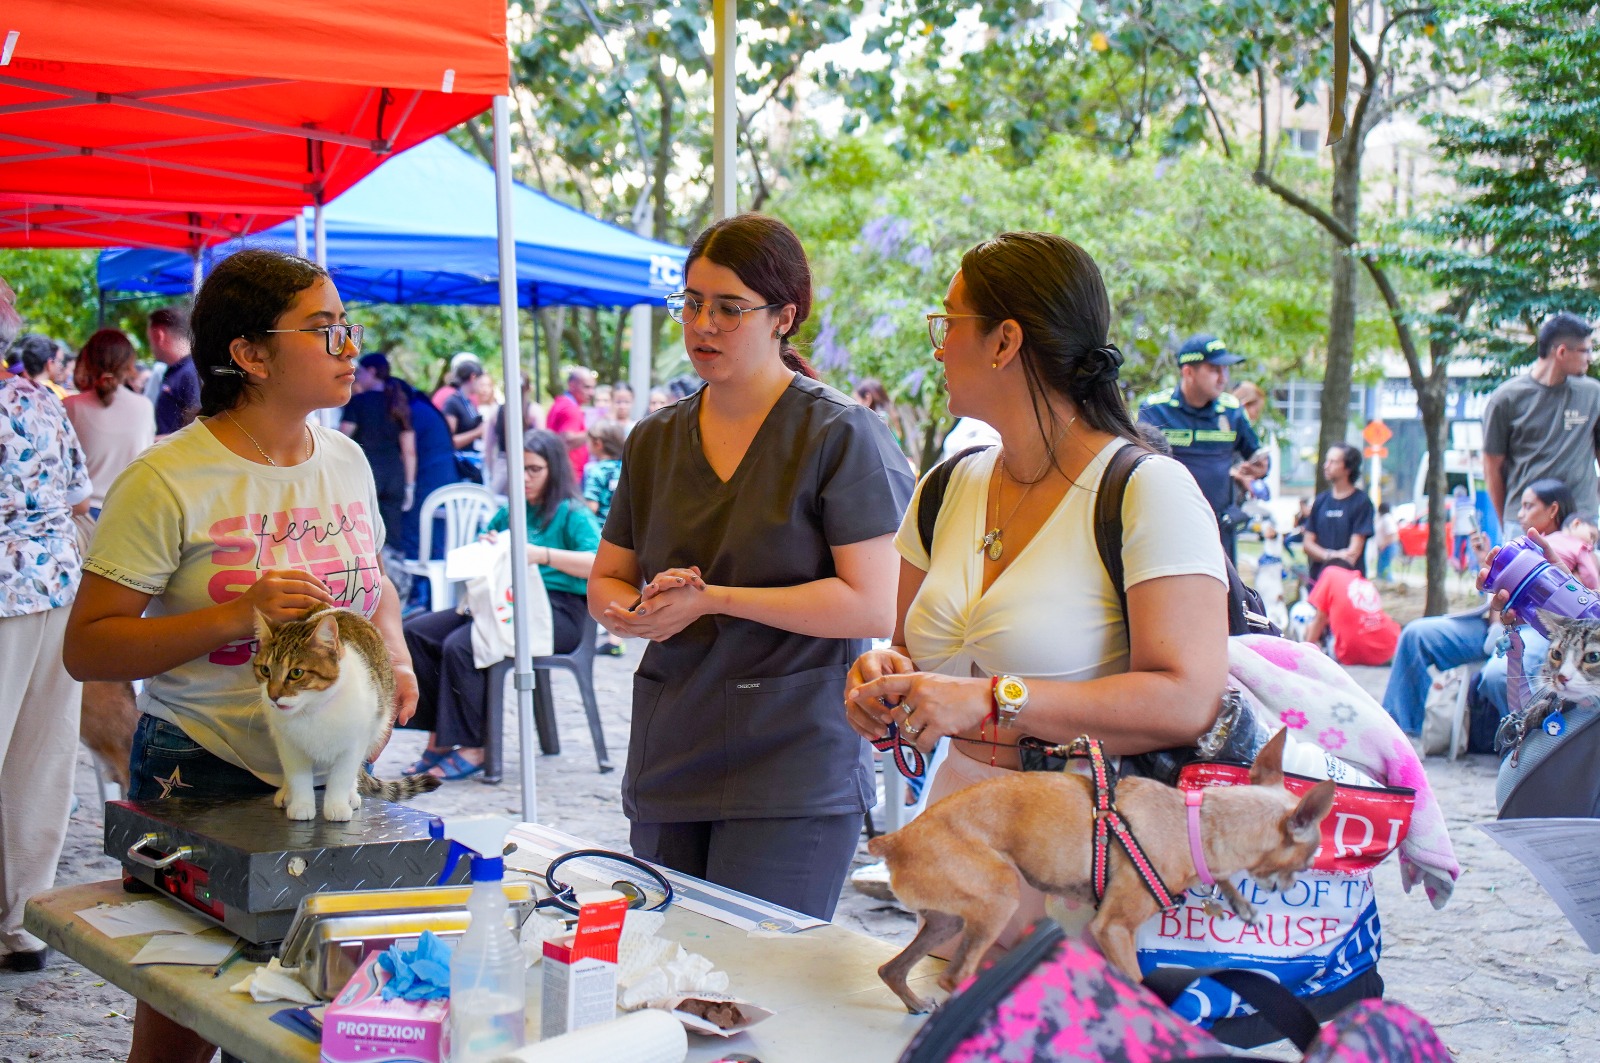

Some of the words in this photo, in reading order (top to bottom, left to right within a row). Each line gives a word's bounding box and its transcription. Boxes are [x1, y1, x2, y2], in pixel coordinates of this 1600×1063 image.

[208, 507, 341, 566] SHE
[1158, 906, 1340, 946] BECAUSE
[336, 1021, 427, 1041] PROTEXION
